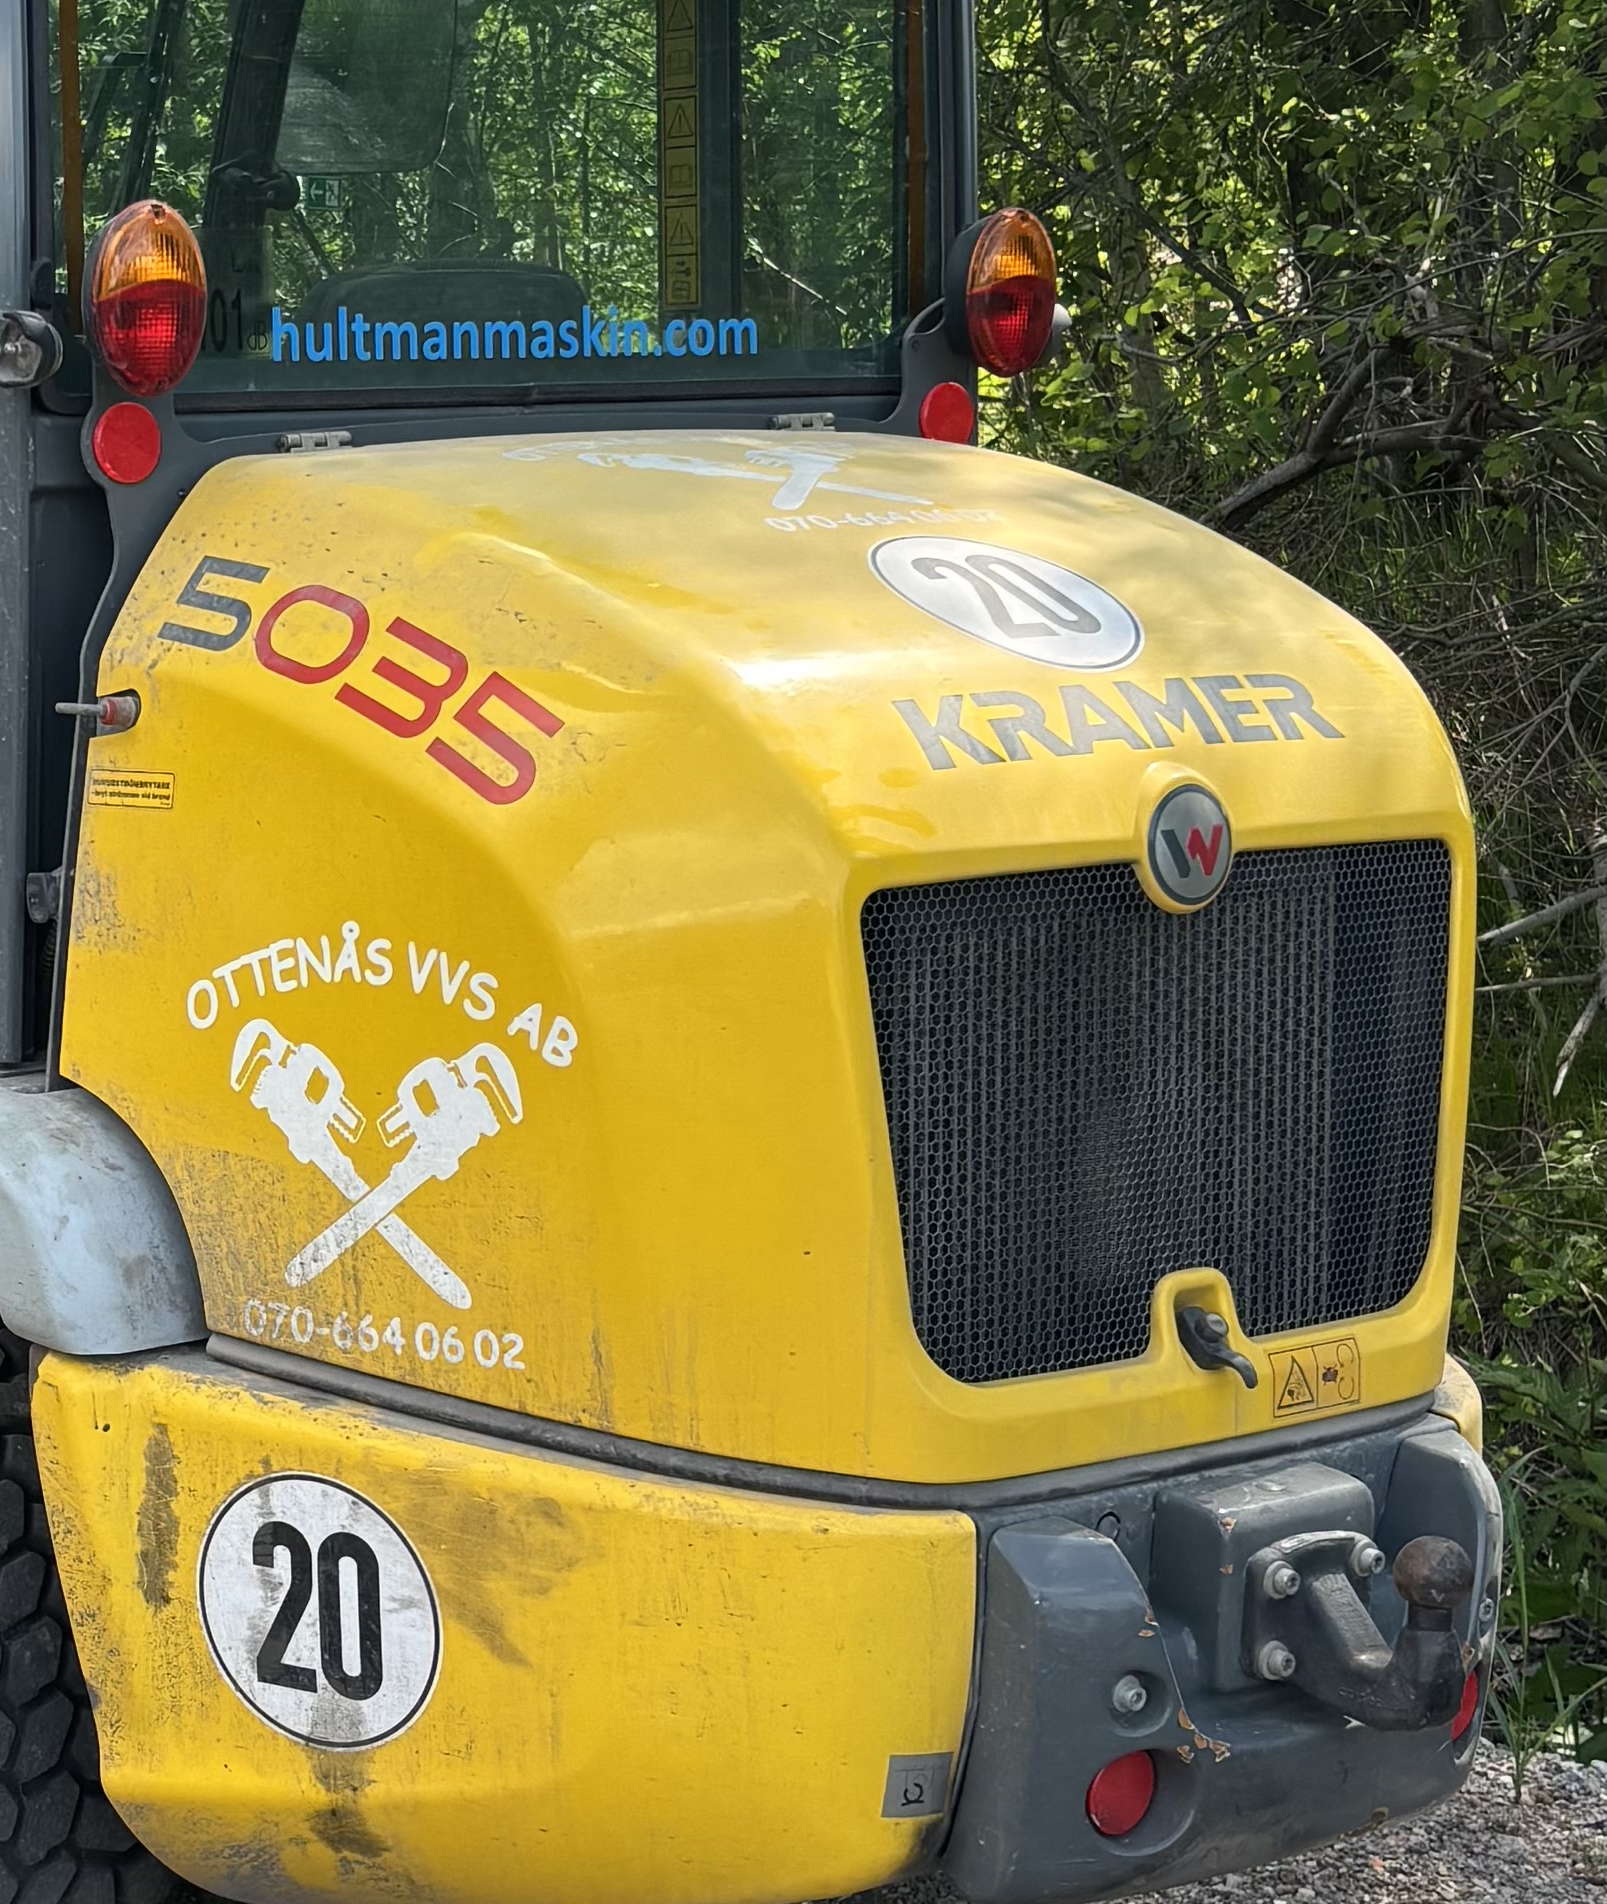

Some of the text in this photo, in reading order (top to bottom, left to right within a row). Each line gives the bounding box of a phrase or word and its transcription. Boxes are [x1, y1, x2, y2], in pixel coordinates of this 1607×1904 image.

[202, 288, 243, 353] 01
[271, 305, 758, 363] hultmanmaskin.com
[911, 554, 1103, 638] 20
[157, 555, 565, 805] 5035
[892, 673, 1345, 771] KRAMER
[186, 921, 579, 1067] OTTENÅS VVS AB
[243, 1298, 525, 1370] 070-664 06 02
[252, 1520, 383, 1701] 20
